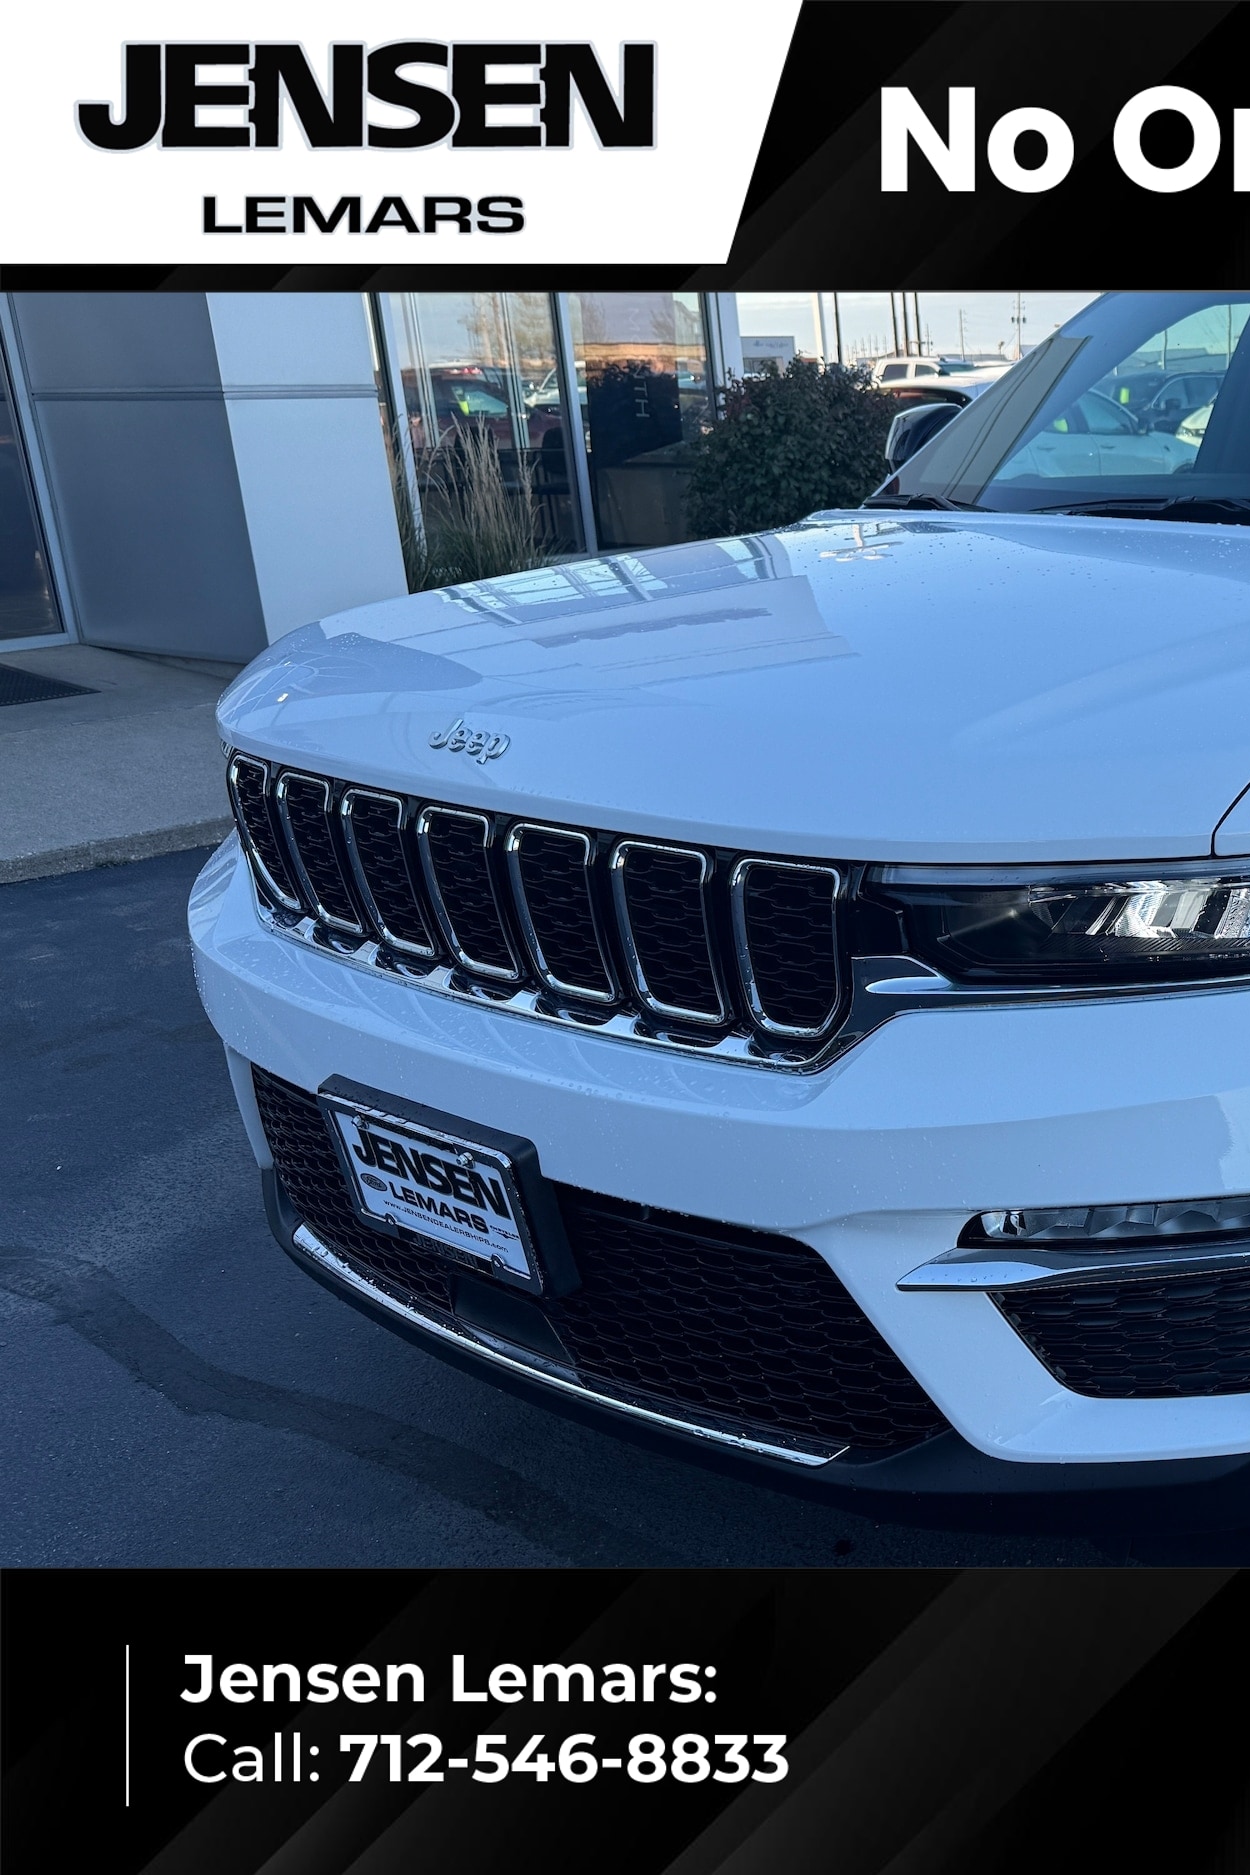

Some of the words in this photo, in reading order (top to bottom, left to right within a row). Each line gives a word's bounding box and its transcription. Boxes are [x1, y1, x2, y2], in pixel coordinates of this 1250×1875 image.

[428, 718, 511, 765] Jeep
[352, 1128, 513, 1220] JENSEN
[388, 1181, 489, 1234] LEMARS
